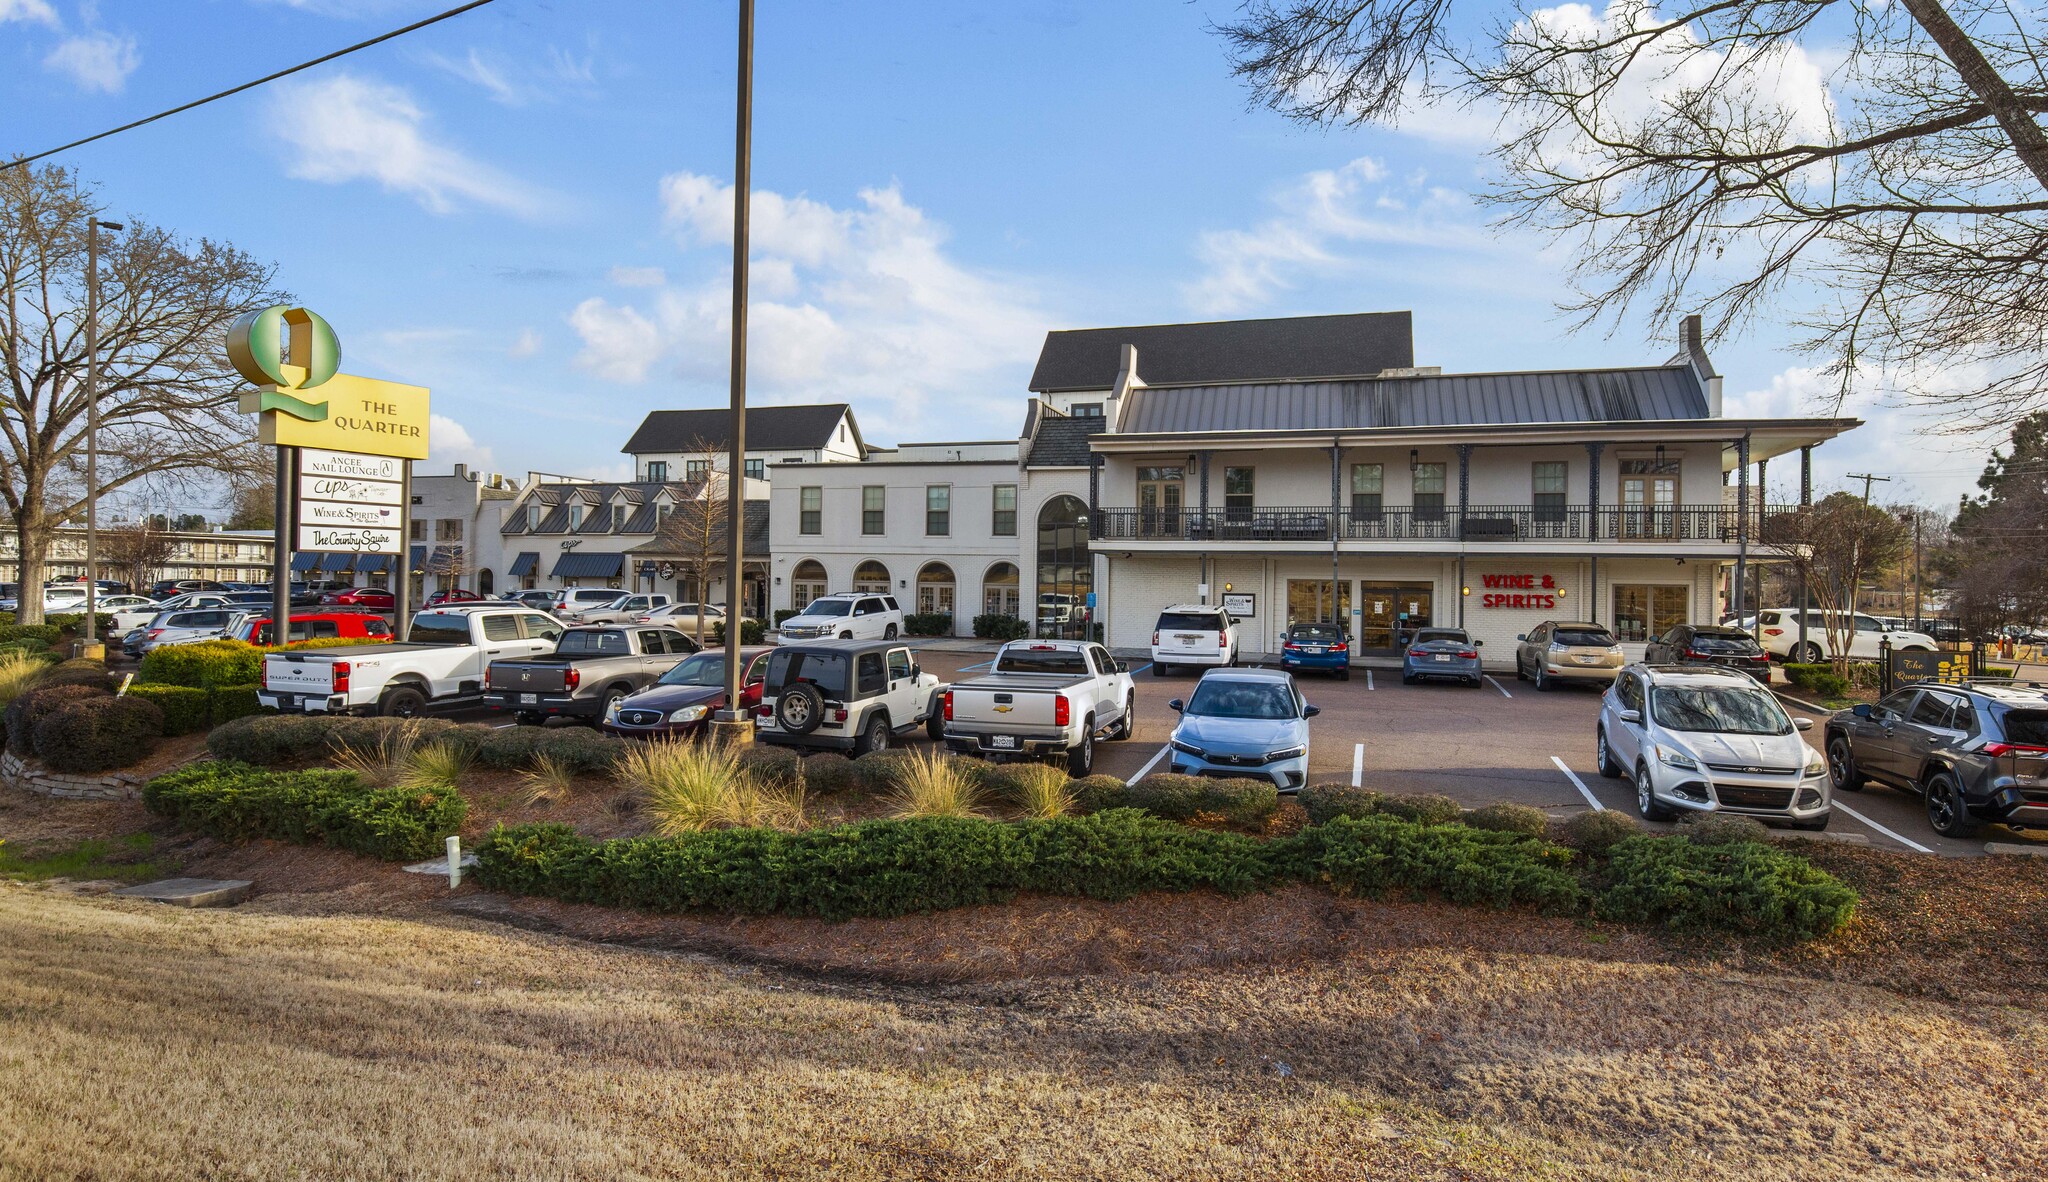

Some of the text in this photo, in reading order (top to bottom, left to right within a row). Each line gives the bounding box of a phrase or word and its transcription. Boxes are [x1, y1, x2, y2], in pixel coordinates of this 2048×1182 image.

[361, 400, 397, 416] THE
[335, 416, 420, 438] QUARTER
[330, 457, 362, 466] ANCEE
[312, 463, 379, 476] NAIL LOUNGE
[313, 530, 391, 552] The Country Squire
[1482, 574, 1555, 589] WINE &
[1483, 594, 1555, 609] SPIRITS
[1903, 659, 1925, 670] The
